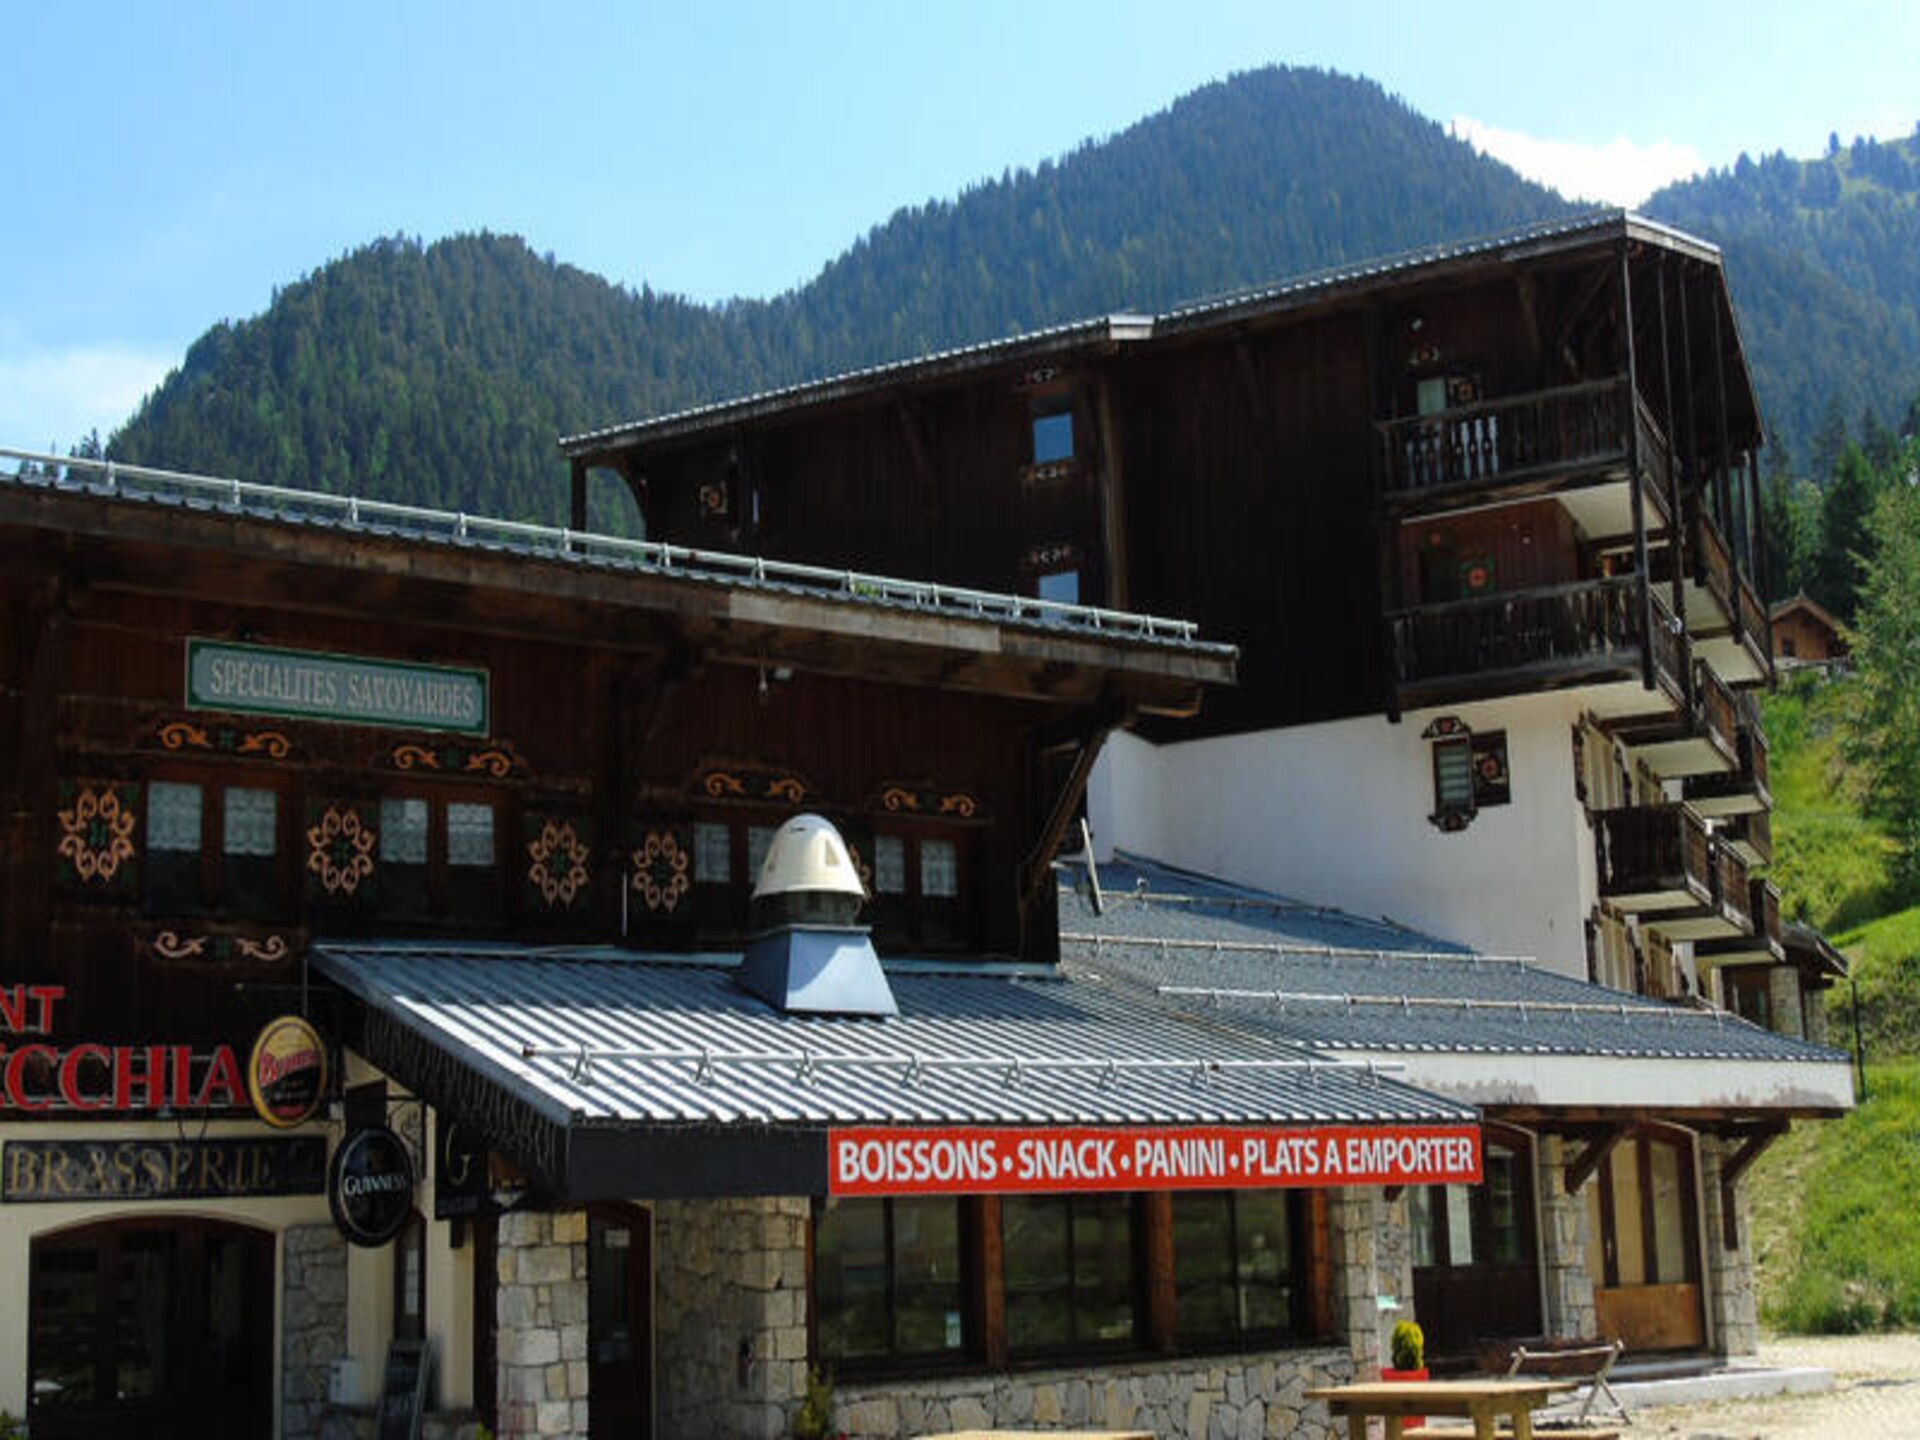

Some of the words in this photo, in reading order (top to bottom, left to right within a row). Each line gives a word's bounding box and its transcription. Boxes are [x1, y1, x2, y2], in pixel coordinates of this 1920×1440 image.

[210, 658, 337, 706] SPECIALITES
[349, 673, 475, 720] SAVOYARDES
[0, 1042, 249, 1111] CCHIA
[10, 1146, 277, 1195] BRASSERIE
[838, 1139, 997, 1183] BOISSONS
[1017, 1138, 1116, 1179] SNACK
[1134, 1137, 1225, 1177] PANINI
[1243, 1138, 1320, 1176] PLATS
[1324, 1137, 1342, 1175] A
[1346, 1136, 1474, 1174] EMPORTER
